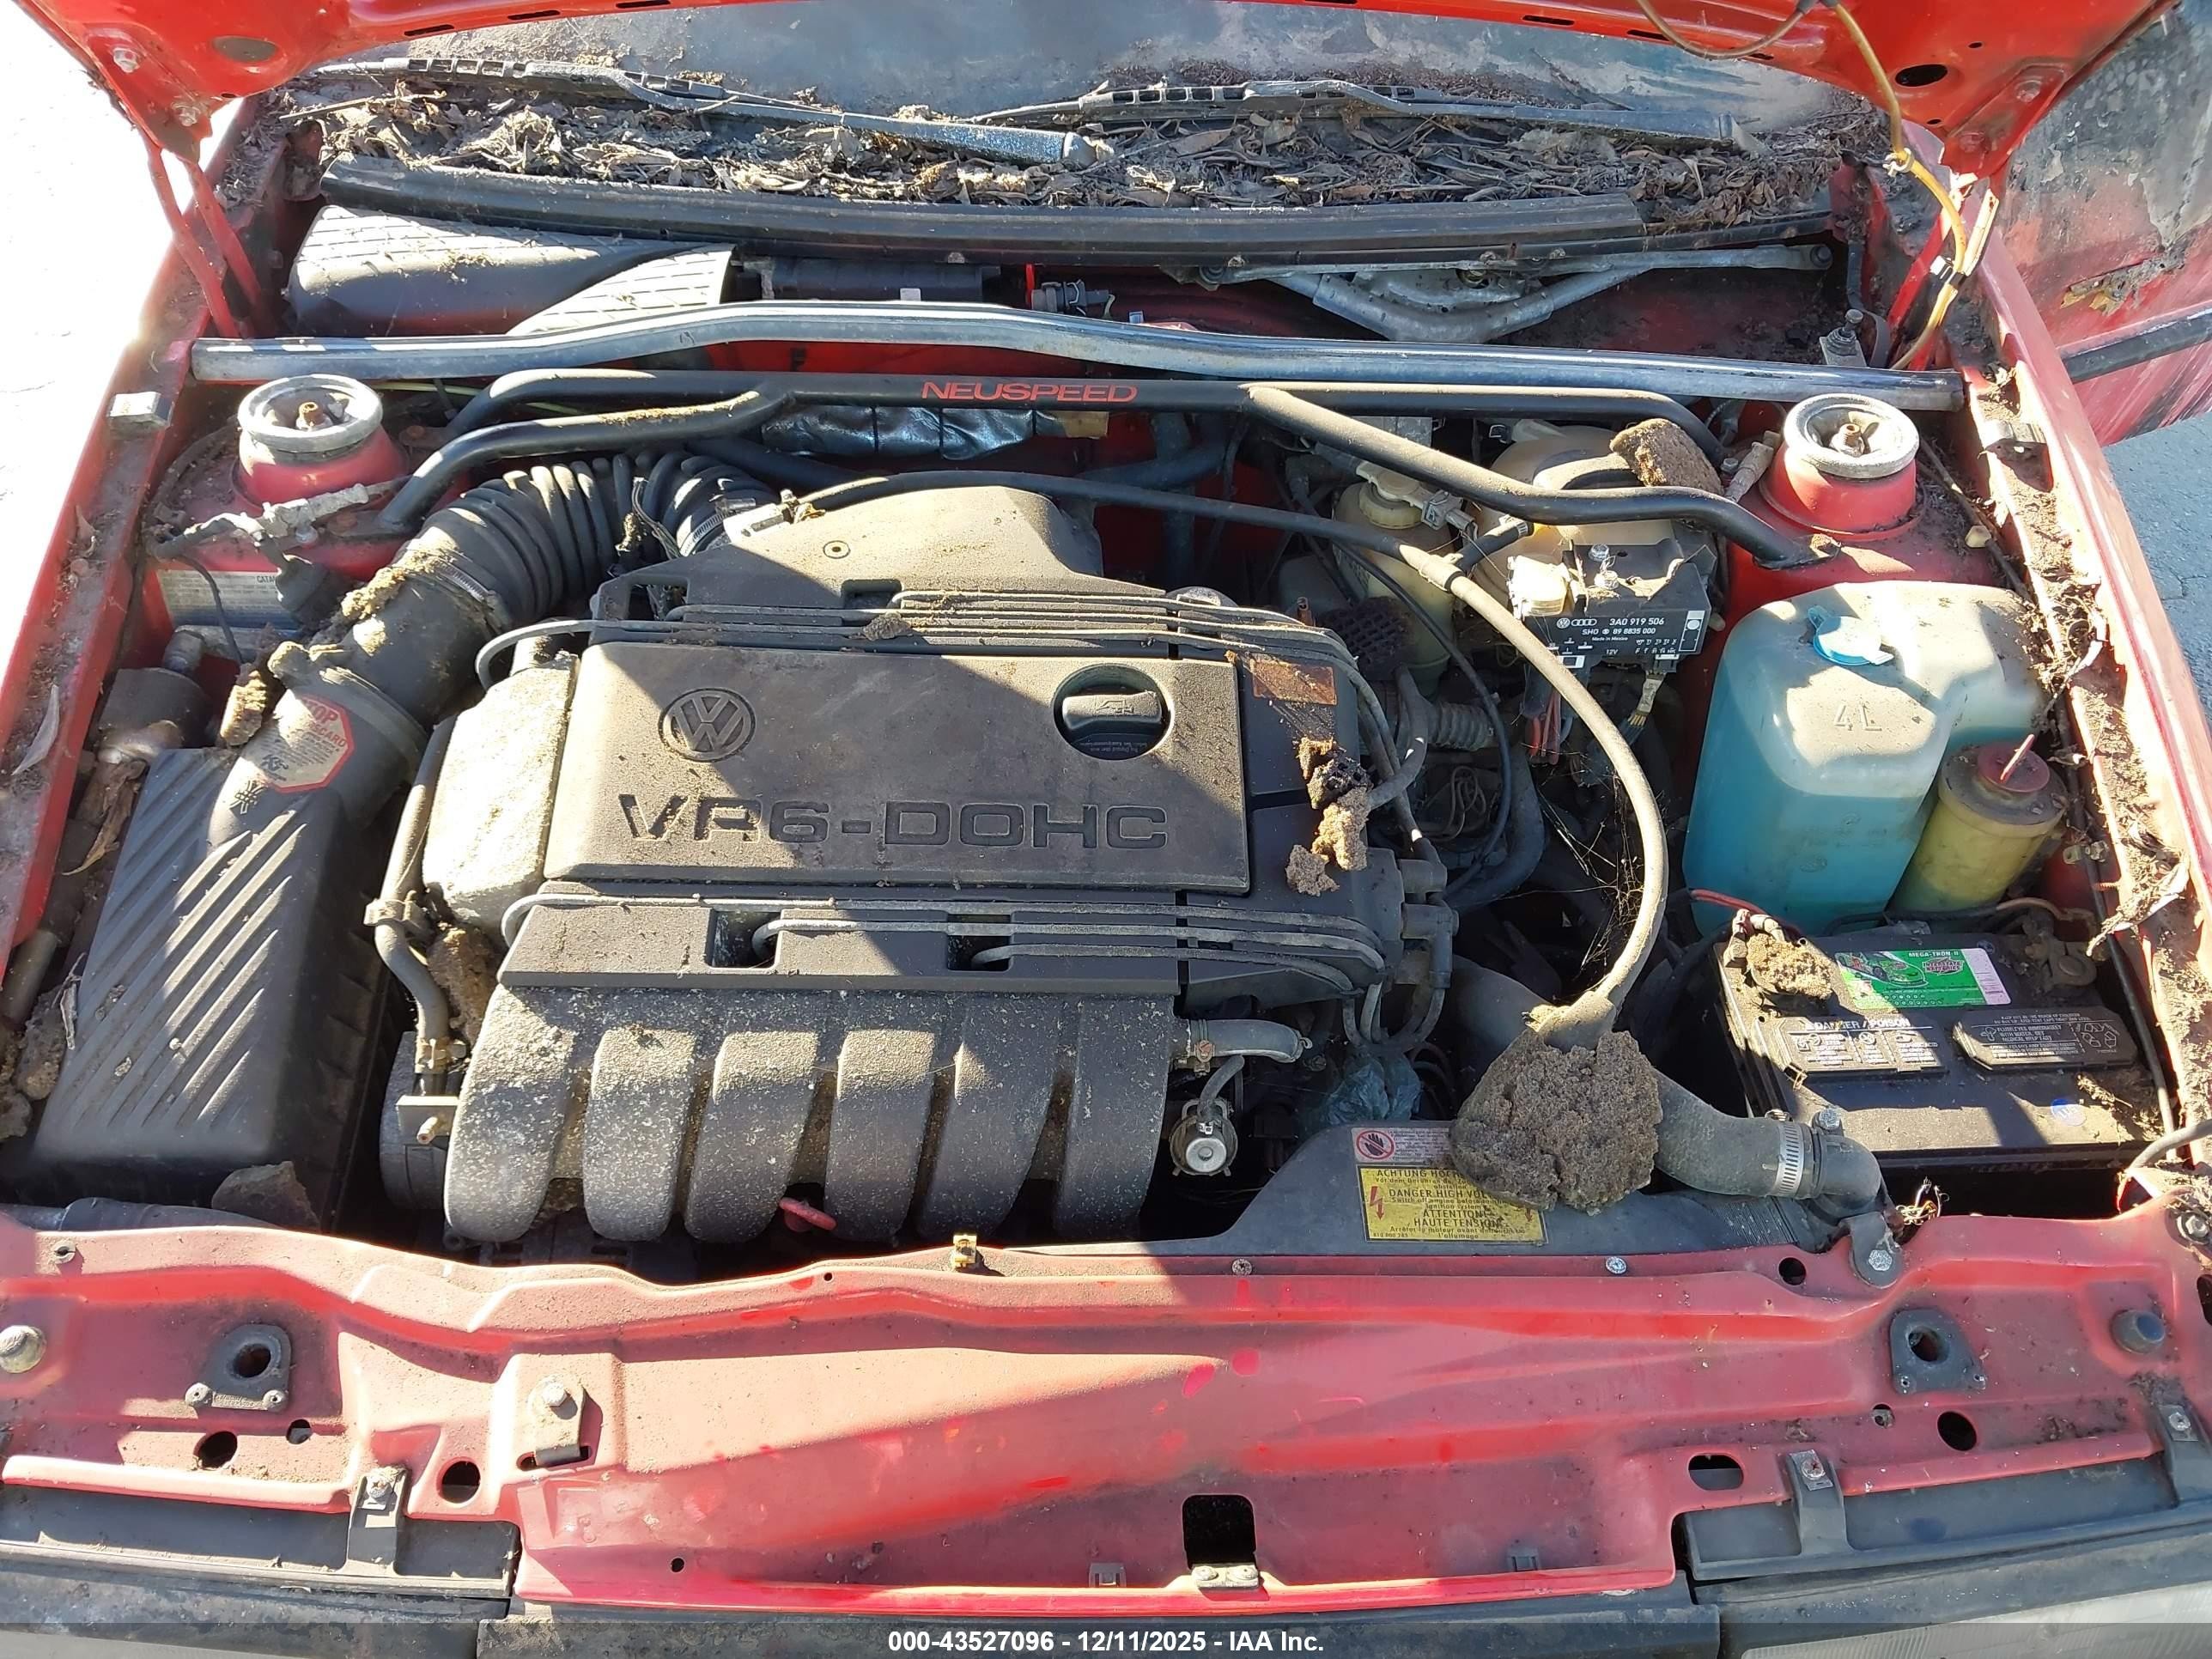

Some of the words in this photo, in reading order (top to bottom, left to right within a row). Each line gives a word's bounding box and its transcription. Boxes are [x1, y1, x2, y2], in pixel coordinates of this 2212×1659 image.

[921, 381, 1139, 403] NEUSPEED
[1834, 704, 1882, 732] 4L
[617, 793, 1169, 850] VR6-DOHC
[1389, 1189, 1432, 1198] DANGER
[1437, 1190, 1463, 1199] HIGH
[1413, 1218, 1448, 1227] HAUTE
